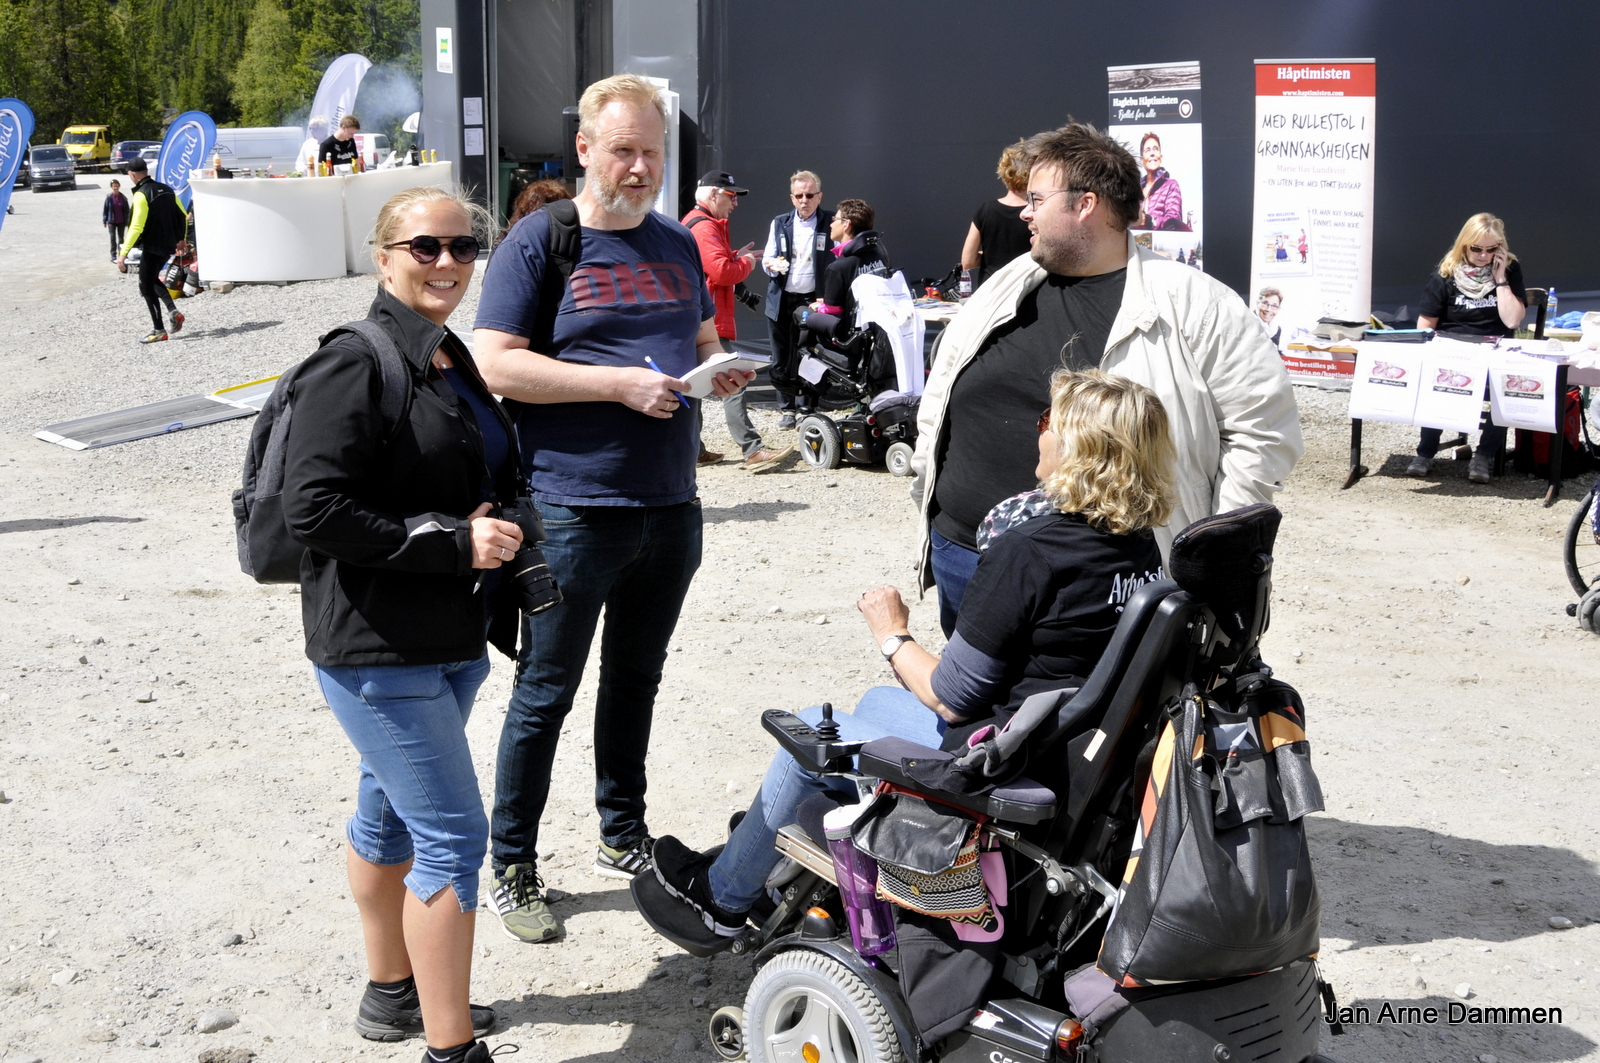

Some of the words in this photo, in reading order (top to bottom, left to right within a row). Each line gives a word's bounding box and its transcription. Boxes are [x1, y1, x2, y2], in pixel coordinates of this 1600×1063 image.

[1277, 67, 1350, 82] Håptimisten
[1112, 97, 1138, 108] Haglebu
[1139, 96, 1178, 107] Håptimisten
[1118, 109, 1134, 122] Fjellet
[1134, 108, 1144, 121] for
[1146, 108, 1156, 118] alle
[1262, 114, 1287, 130] MED
[1292, 113, 1356, 131] RULLESTOL
[1361, 116, 1366, 130] I
[1257, 140, 1370, 160] GRØNNSAKSHEISEN
[1277, 178, 1292, 186] LITEN
[1294, 179, 1304, 187] BOK
[1320, 180, 1337, 188] STORT
[1338, 182, 1362, 190] BUDSKAP
